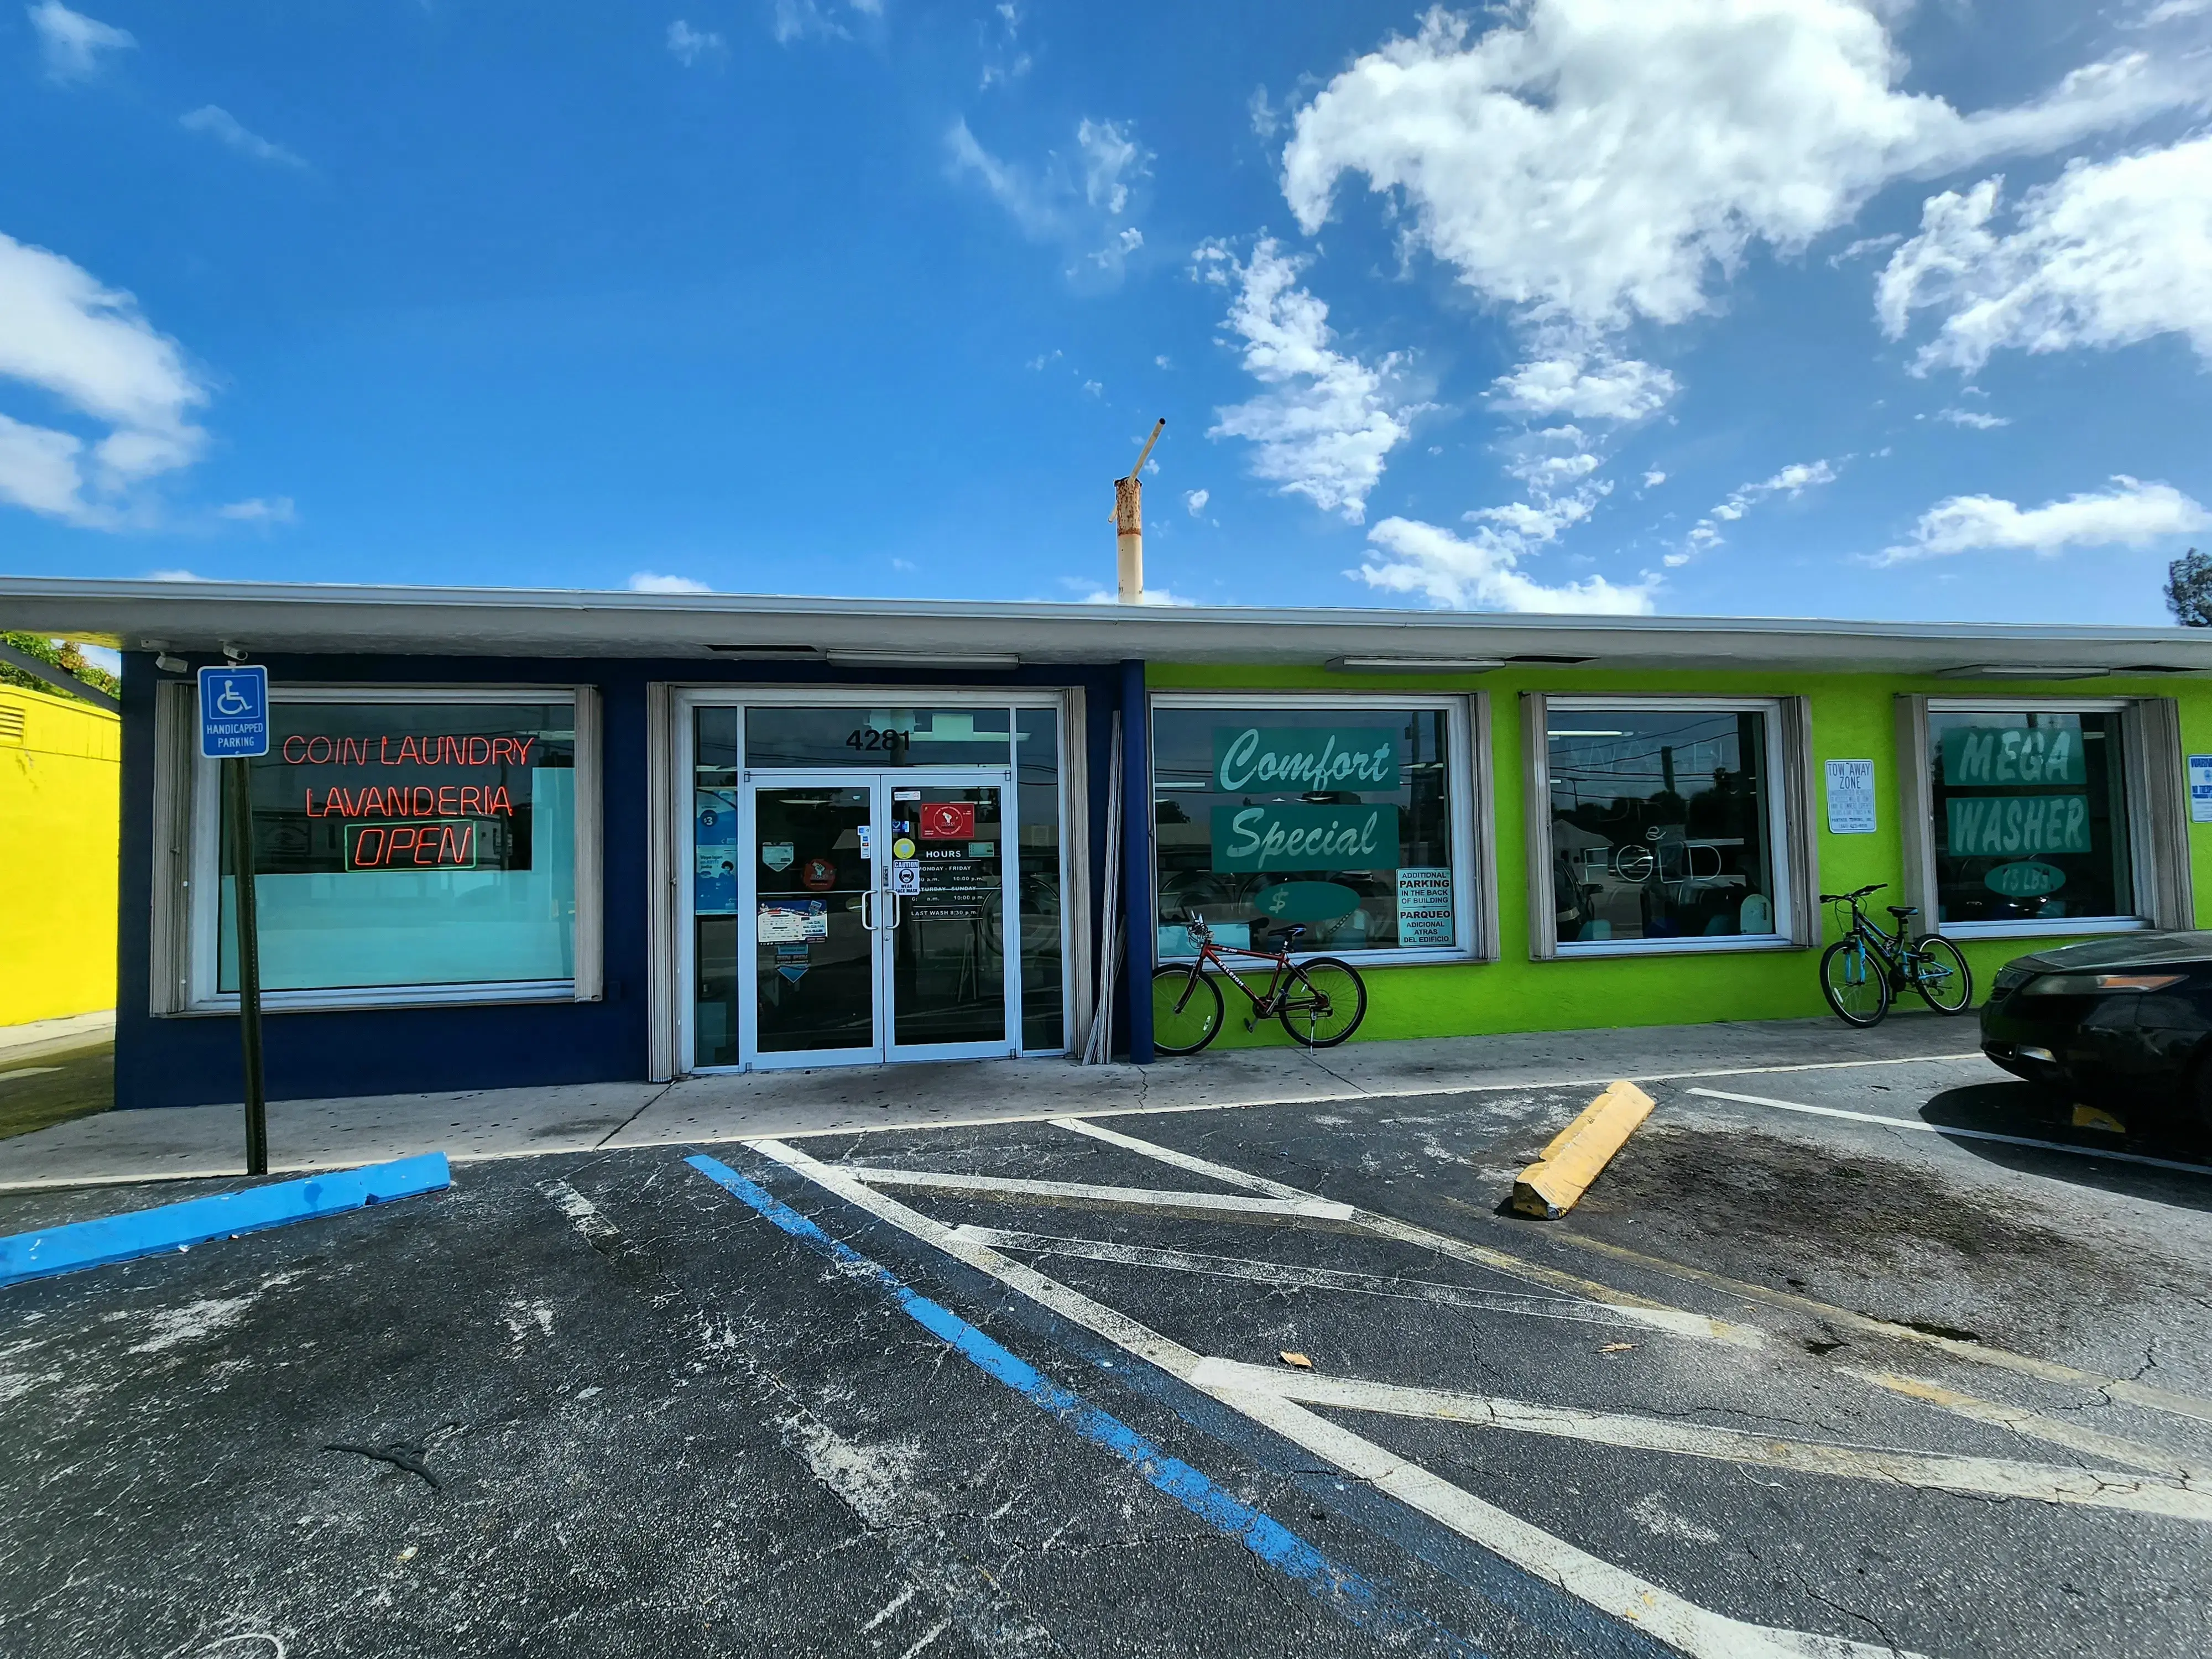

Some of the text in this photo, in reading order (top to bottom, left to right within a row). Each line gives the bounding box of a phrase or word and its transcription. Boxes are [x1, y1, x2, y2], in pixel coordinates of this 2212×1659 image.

[207, 723, 263, 734] HANDICAPPED
[846, 729, 909, 750] 4281
[218, 737, 254, 748] PARKING
[283, 735, 535, 765] COIN LAUNDRY
[1220, 729, 1390, 791] Comfort
[1959, 731, 2070, 781] MEGA
[1827, 763, 1870, 776] TOW AWAY
[1840, 776, 1861, 789] ZONE
[306, 785, 513, 817] LAVANDERIA
[1955, 798, 2084, 852] WASHER
[354, 827, 471, 865] OPEN
[1226, 807, 1378, 869] Special
[1400, 879, 1449, 888] PARKING
[1269, 888, 1289, 913] $
[1400, 910, 1451, 919] PARQUEO
[1218, 961, 1244, 987] RALEIGH
